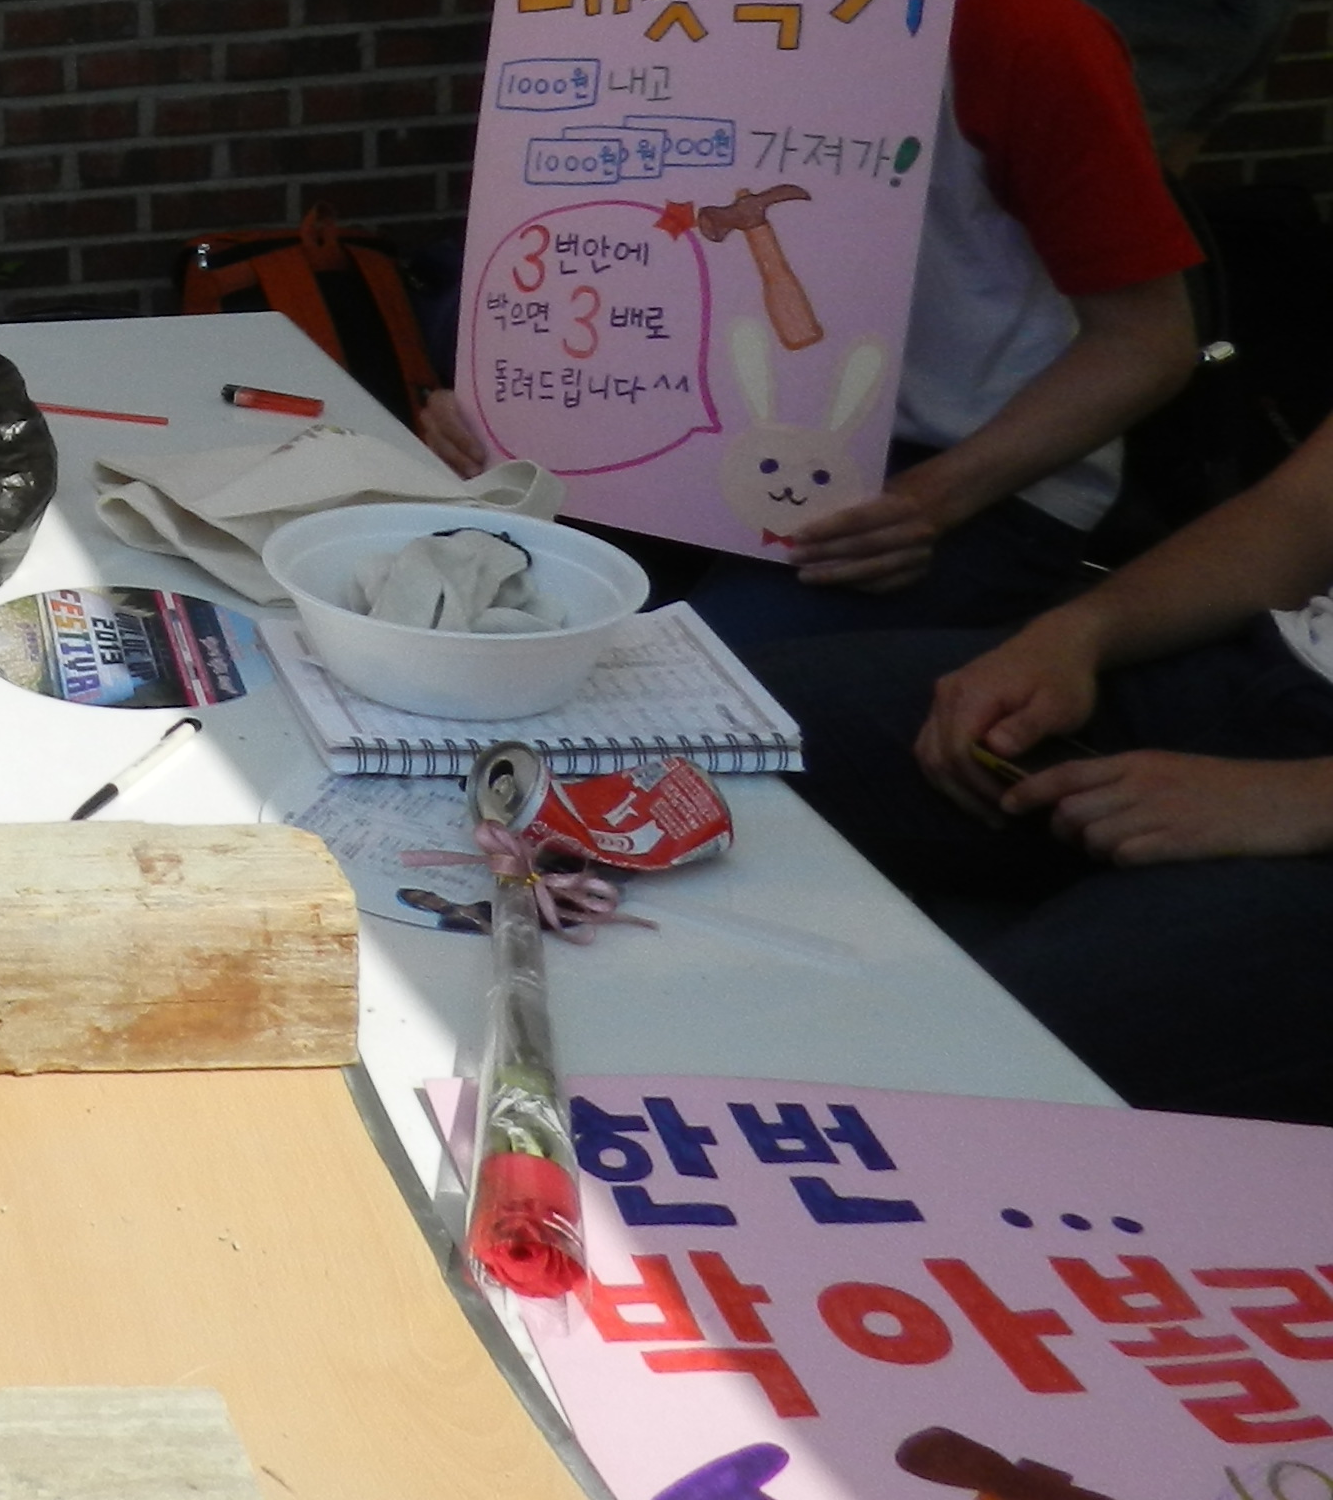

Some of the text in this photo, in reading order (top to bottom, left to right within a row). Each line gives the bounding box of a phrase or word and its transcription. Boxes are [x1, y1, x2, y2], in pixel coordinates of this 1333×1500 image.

[507, 65, 673, 101] 1000원 내고
[535, 144, 616, 176] 1000원
[487, 292, 550, 333] 박으면
[91, 616, 125, 665] 2013
